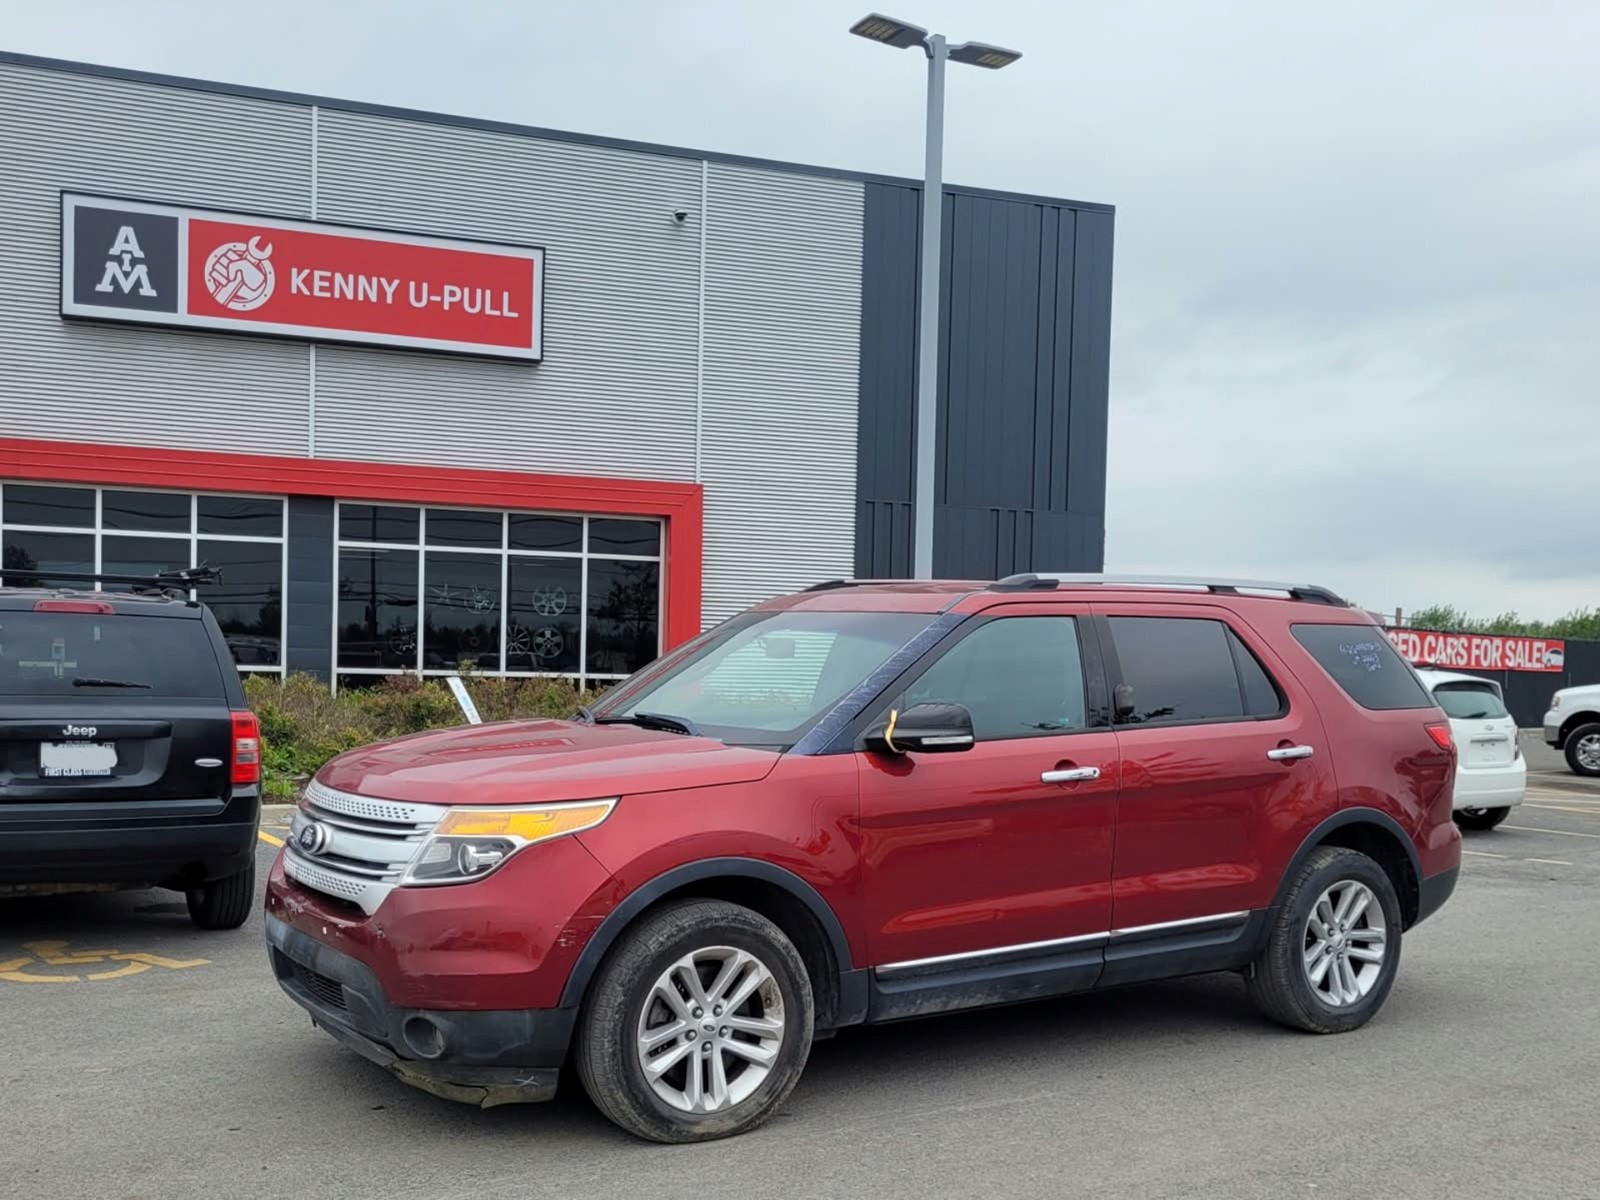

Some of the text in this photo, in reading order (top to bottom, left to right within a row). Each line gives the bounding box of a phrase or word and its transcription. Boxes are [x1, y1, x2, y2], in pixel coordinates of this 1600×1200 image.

[291, 267, 519, 318] KENNY U-PULL
[1424, 635, 1468, 666] CARS
[1471, 638, 1502, 667] FOR
[1505, 640, 1546, 668] SALE!
[62, 724, 97, 737] Jeep
